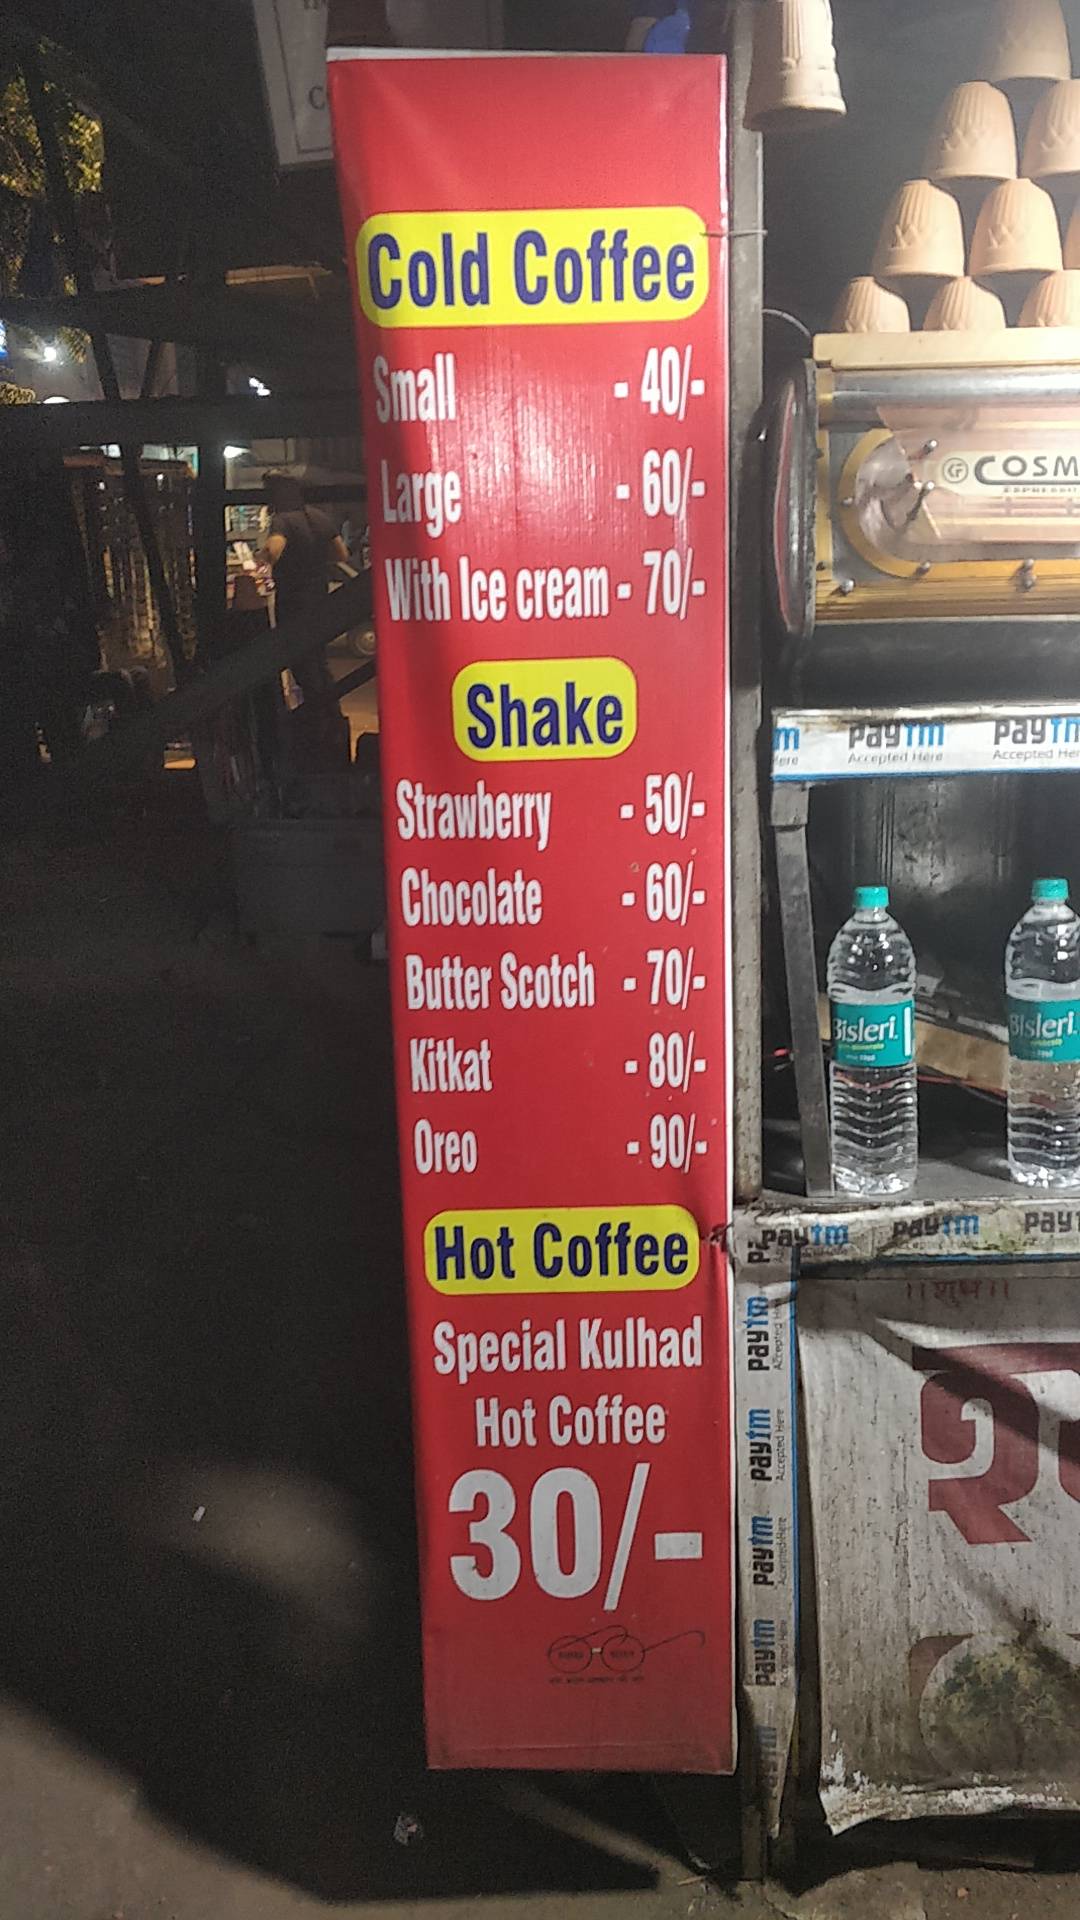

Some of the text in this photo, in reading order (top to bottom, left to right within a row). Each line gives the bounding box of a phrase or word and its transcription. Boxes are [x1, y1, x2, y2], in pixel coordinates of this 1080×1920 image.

[369, 229, 694, 308] Cold Coffee
[374, 353, 457, 422] Small
[640, 345, 705, 420] 40/-
[381, 461, 463, 538] Large
[641, 448, 705, 524] 60/-
[385, 558, 450, 621] With
[459, 556, 507, 621] Ice
[516, 567, 609, 620] cream
[642, 548, 705, 620] 70/-
[466, 682, 623, 750] Shake
[848, 751, 944, 766] Accepted Here
[992, 749, 1054, 762] Accepted
[396, 778, 551, 851] Strawberry
[645, 771, 706, 839] 50/-
[401, 867, 543, 928] Chocolate
[645, 861, 705, 926] 60/-
[405, 953, 492, 1011] Butter
[500, 951, 595, 1009] Scotch
[646, 947, 706, 1009] 70/-
[409, 1037, 493, 1093] Kitkat
[648, 1031, 707, 1093] 80/-
[413, 1119, 478, 1174] Oreo
[650, 1113, 707, 1174] 90/-
[435, 1226, 515, 1280] Hot
[533, 1222, 688, 1277] Coffee
[433, 1315, 703, 1384] Special Kulhad
[475, 1394, 666, 1448] Hot Coffee
[776, 1408, 786, 1481] Accepted Here
[447, 1462, 703, 1611] 30/-
